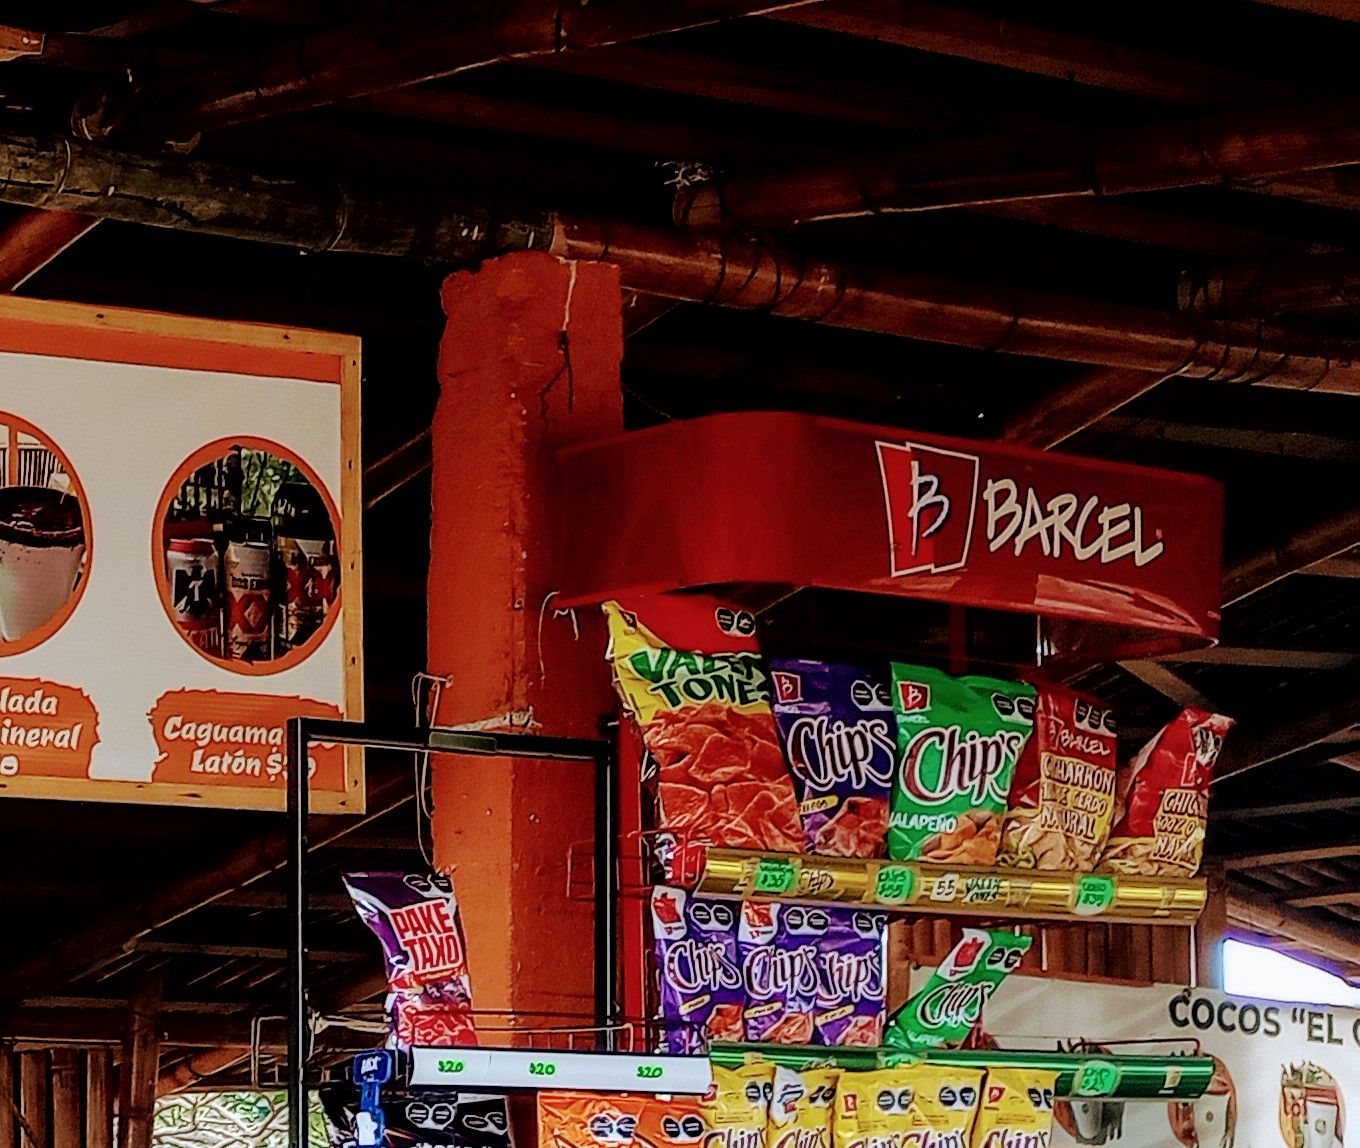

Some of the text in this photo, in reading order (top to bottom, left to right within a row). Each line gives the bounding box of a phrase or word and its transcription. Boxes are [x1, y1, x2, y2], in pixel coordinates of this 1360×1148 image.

[982, 479, 1164, 566] BARCEL
[163, 714, 284, 748] Caguama
[190, 749, 263, 778] Latón
[890, 811, 957, 834] JALAPEÑO
[936, 877, 955, 896] 55
[390, 901, 453, 940] PAKE
[1168, 993, 1344, 1046] COCOS “EL
[437, 1059, 464, 1074] $20
[529, 1062, 556, 1077] $20
[636, 1064, 664, 1080] $20
